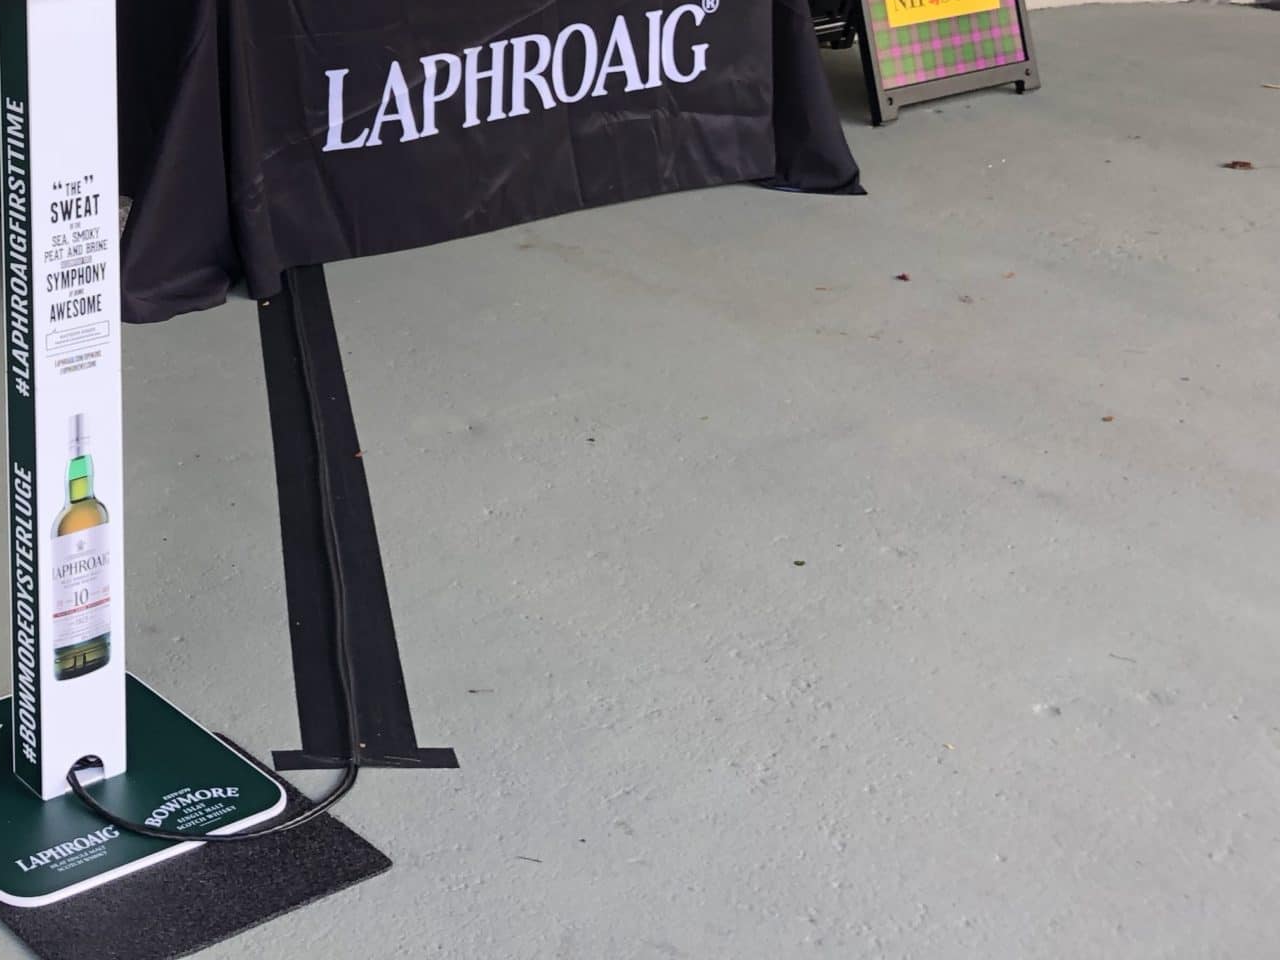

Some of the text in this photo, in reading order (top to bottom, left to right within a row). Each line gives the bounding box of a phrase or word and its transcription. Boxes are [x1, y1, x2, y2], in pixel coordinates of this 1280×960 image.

[50, 193, 101, 224] SWEAT
[5, 96, 31, 399] #LAPHROAIGFIRSTTIME
[72, 226, 101, 244] SMOKY
[44, 247, 64, 264] PEAT
[66, 244, 84, 258] AND
[86, 239, 109, 255] BRINE
[46, 261, 107, 293] SYMPHONY
[49, 293, 103, 324] AWESOME
[73, 588, 89, 607] 10
[14, 462, 38, 765] #BOWMOREOYSTERLUGE
[144, 786, 240, 828] BOWMORE
[176, 802, 225, 824] SINGLE MALT
[182, 802, 207, 815] ISLAY
[207, 805, 237, 821] WHISKY
[14, 824, 121, 873] LAPHROAIG
